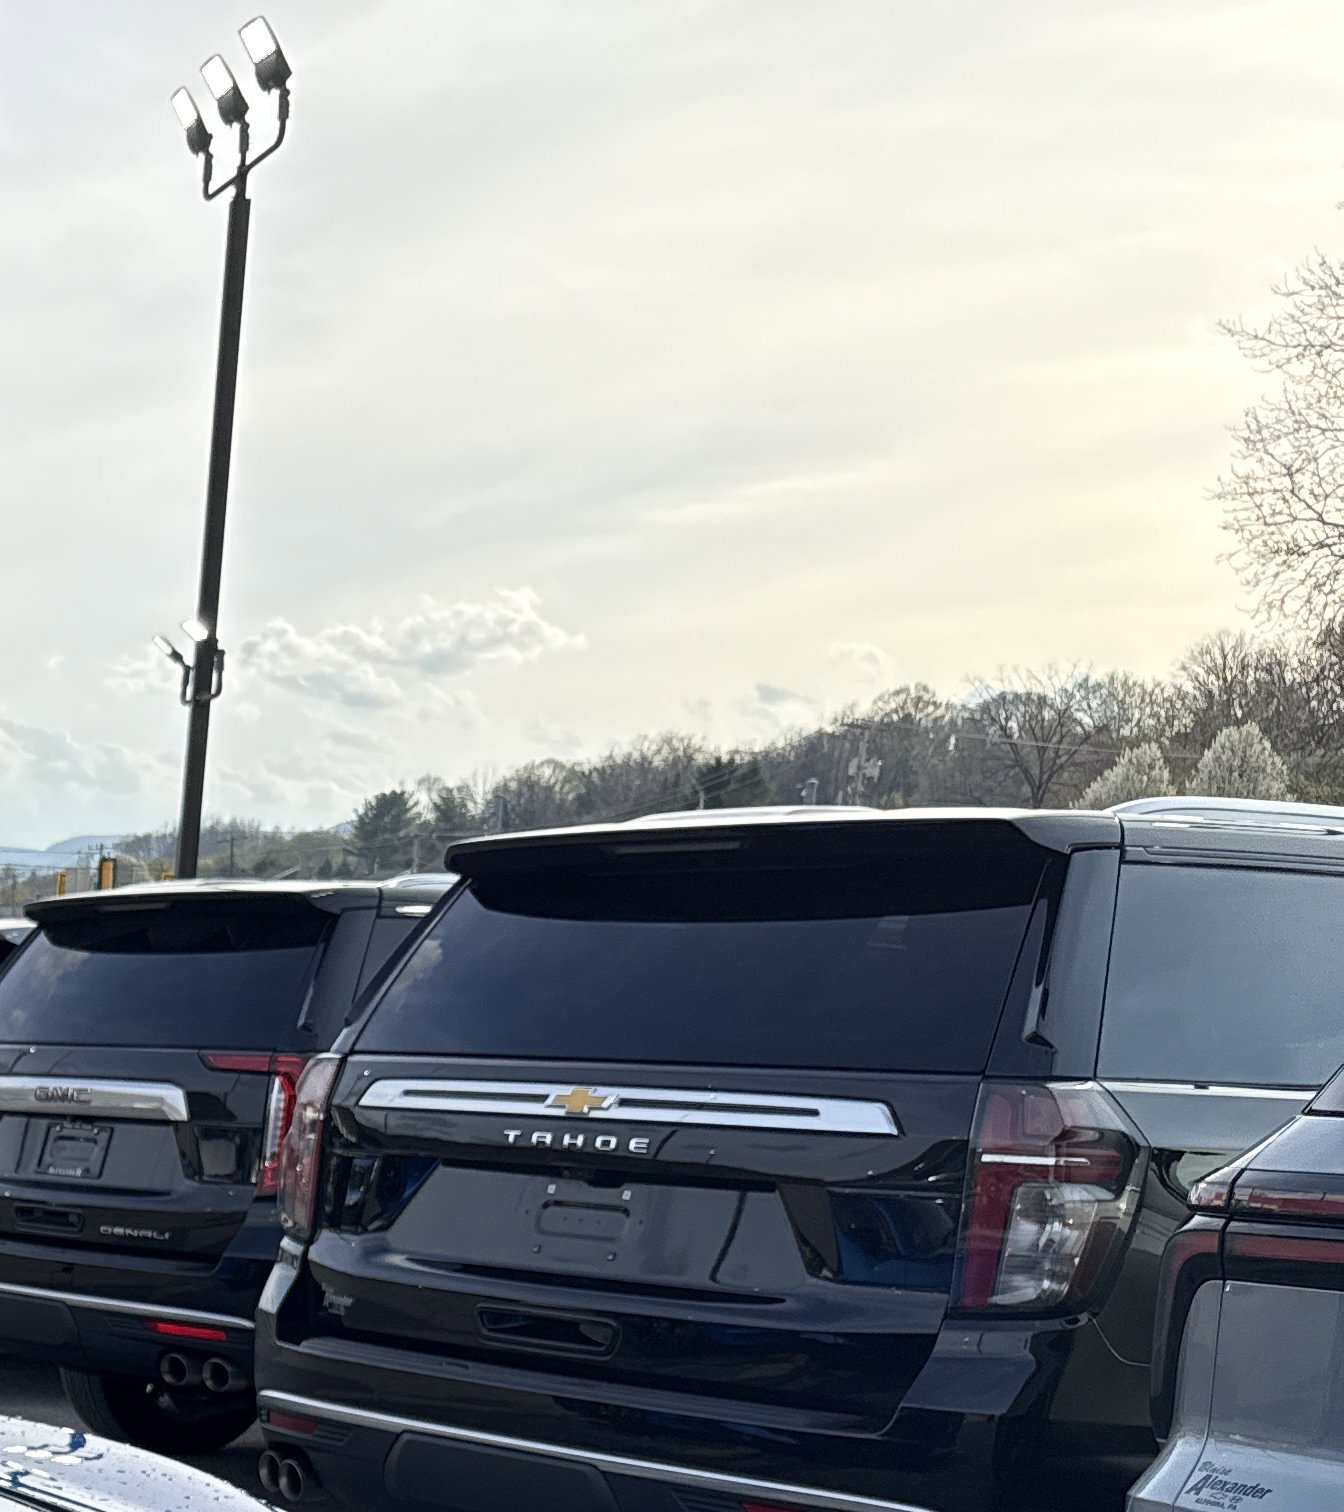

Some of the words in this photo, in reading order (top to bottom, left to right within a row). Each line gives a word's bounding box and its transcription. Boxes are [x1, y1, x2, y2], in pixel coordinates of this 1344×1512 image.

[34, 1086, 93, 1105] GMC
[503, 1129, 650, 1154] TAHOE
[99, 1225, 170, 1240] DENALI
[1184, 1474, 1273, 1500] Alexander
